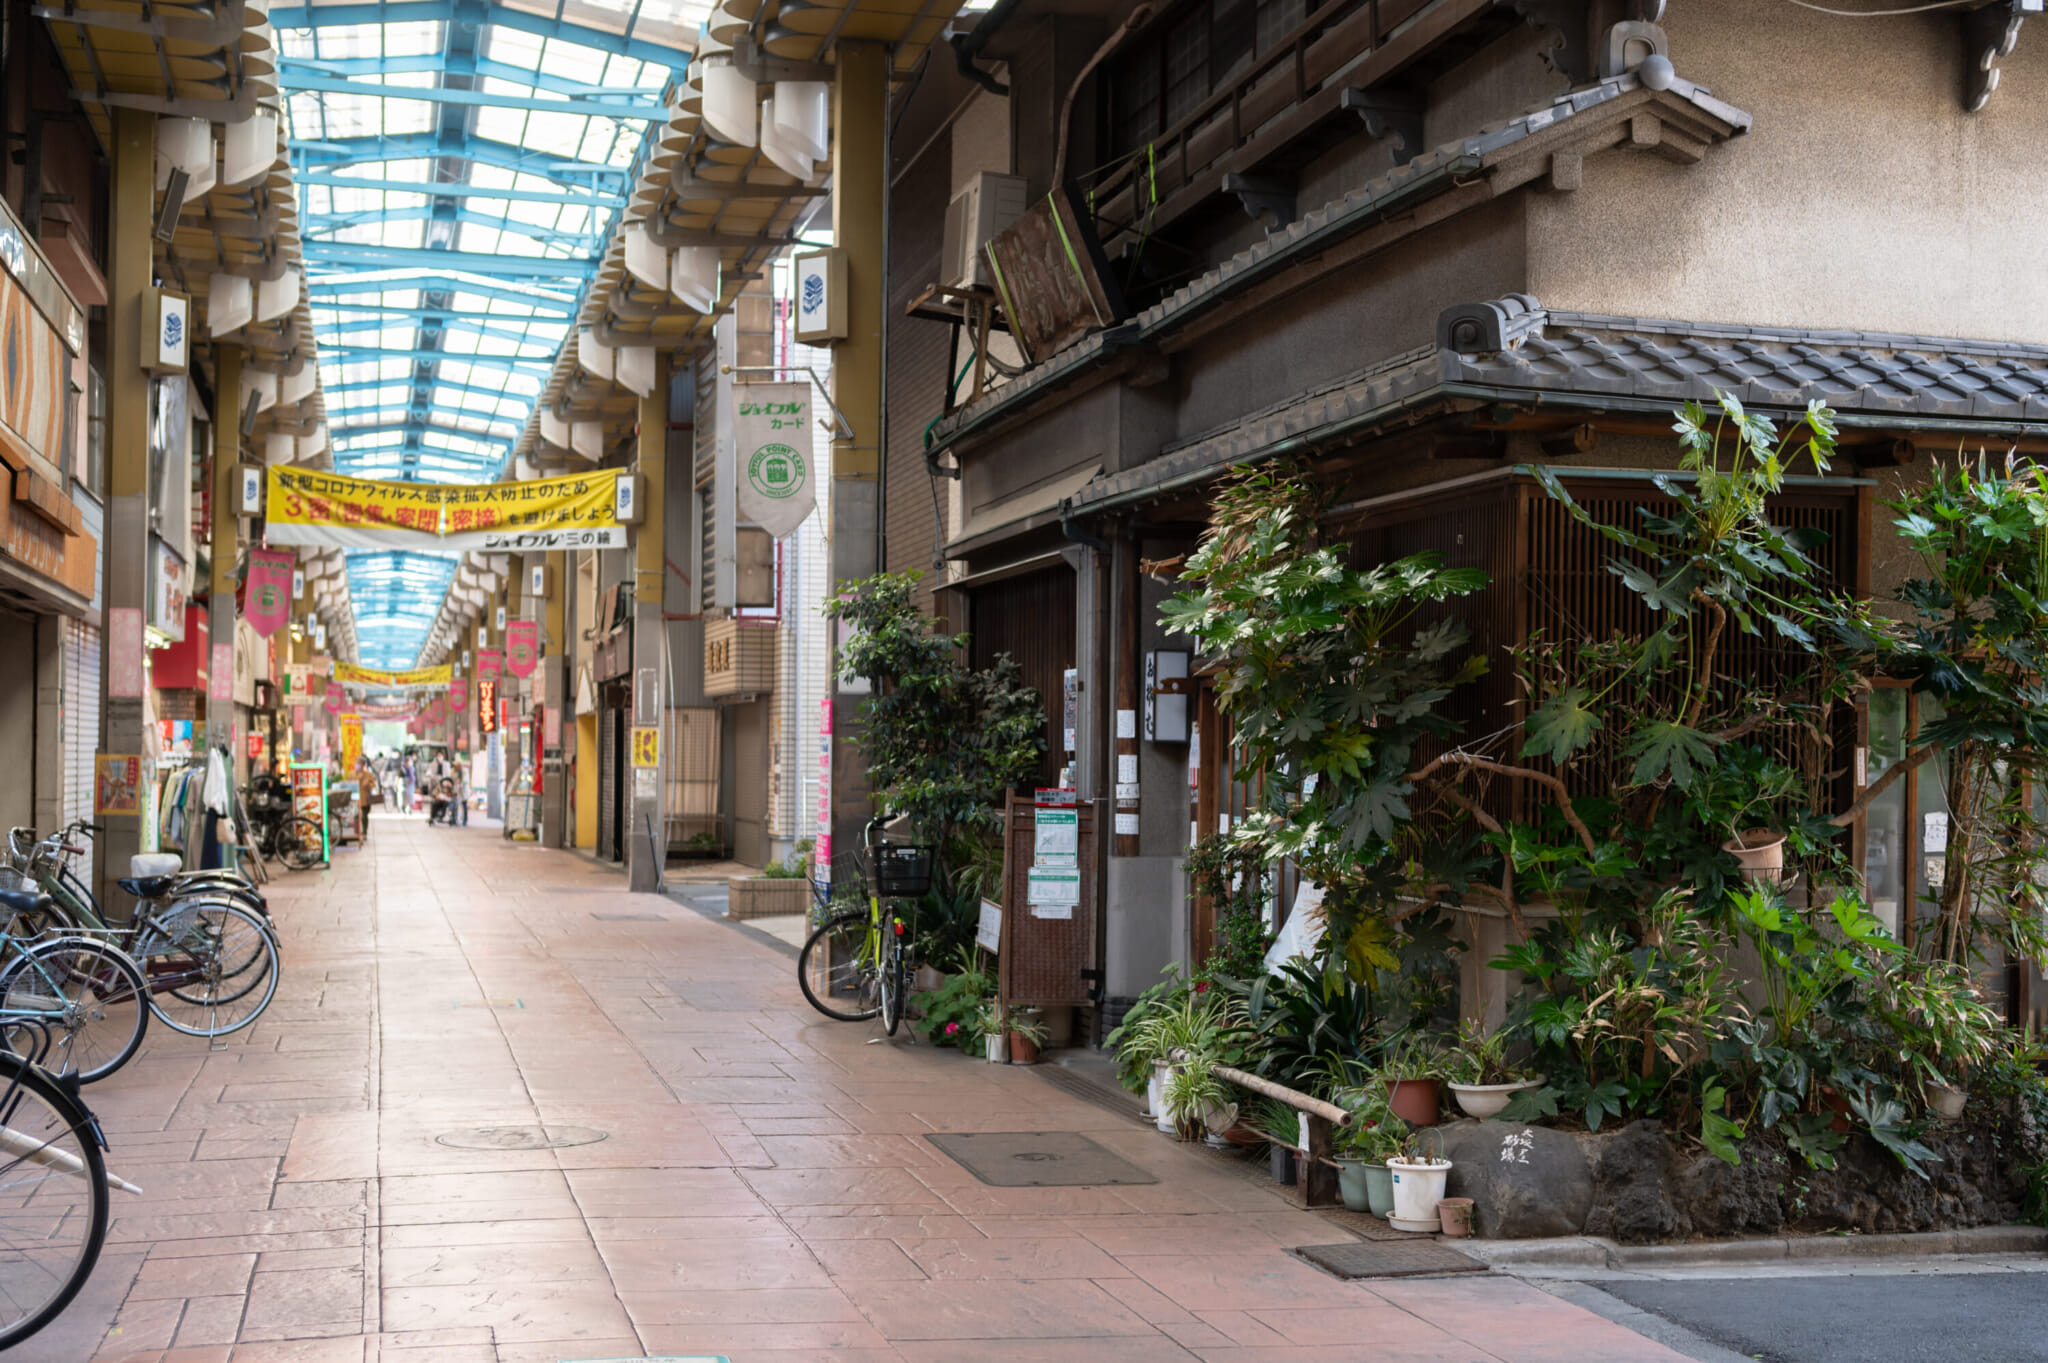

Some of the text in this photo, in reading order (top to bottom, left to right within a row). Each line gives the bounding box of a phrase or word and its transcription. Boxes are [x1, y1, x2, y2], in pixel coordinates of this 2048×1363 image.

[739, 402, 804, 416] ジョイフル
[771, 417, 805, 430] カード
